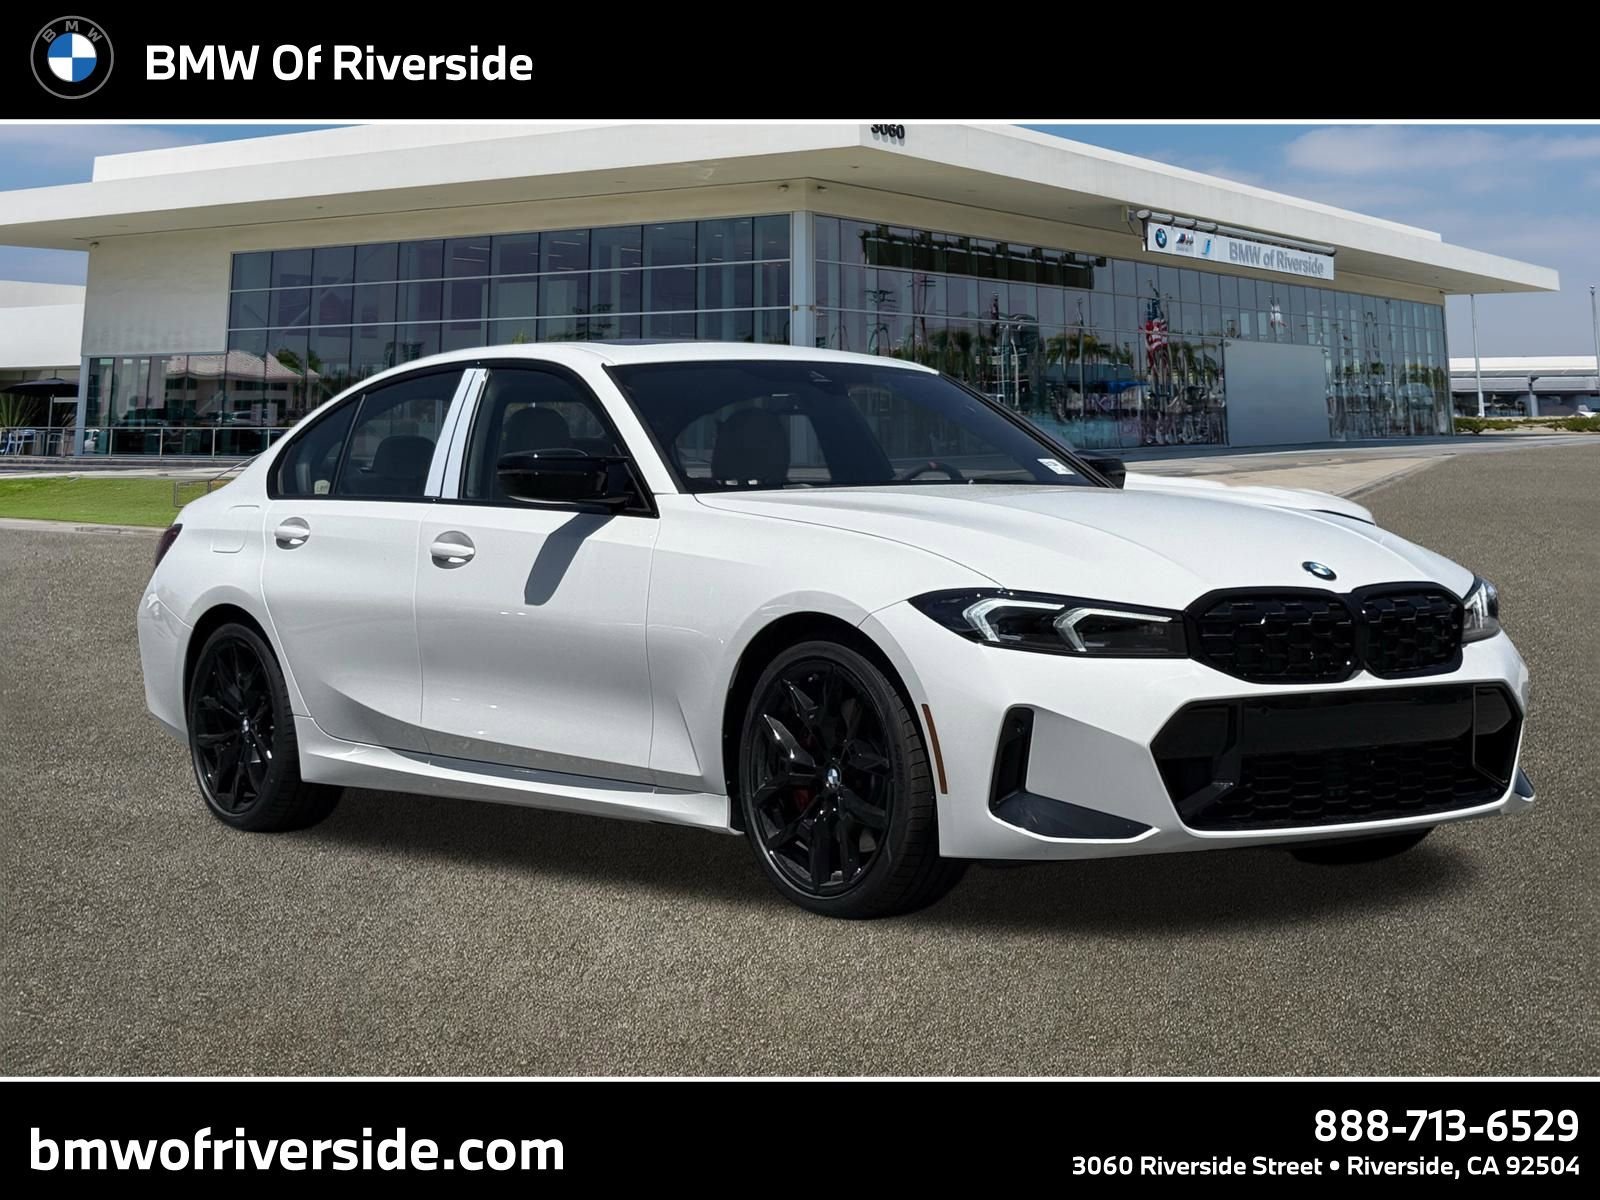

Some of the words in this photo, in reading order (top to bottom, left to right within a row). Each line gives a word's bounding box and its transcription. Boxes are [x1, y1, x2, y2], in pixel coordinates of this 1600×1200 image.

[1229, 242, 1261, 265] BMW
[1263, 249, 1275, 267] of
[1276, 251, 1324, 275] Riverside
